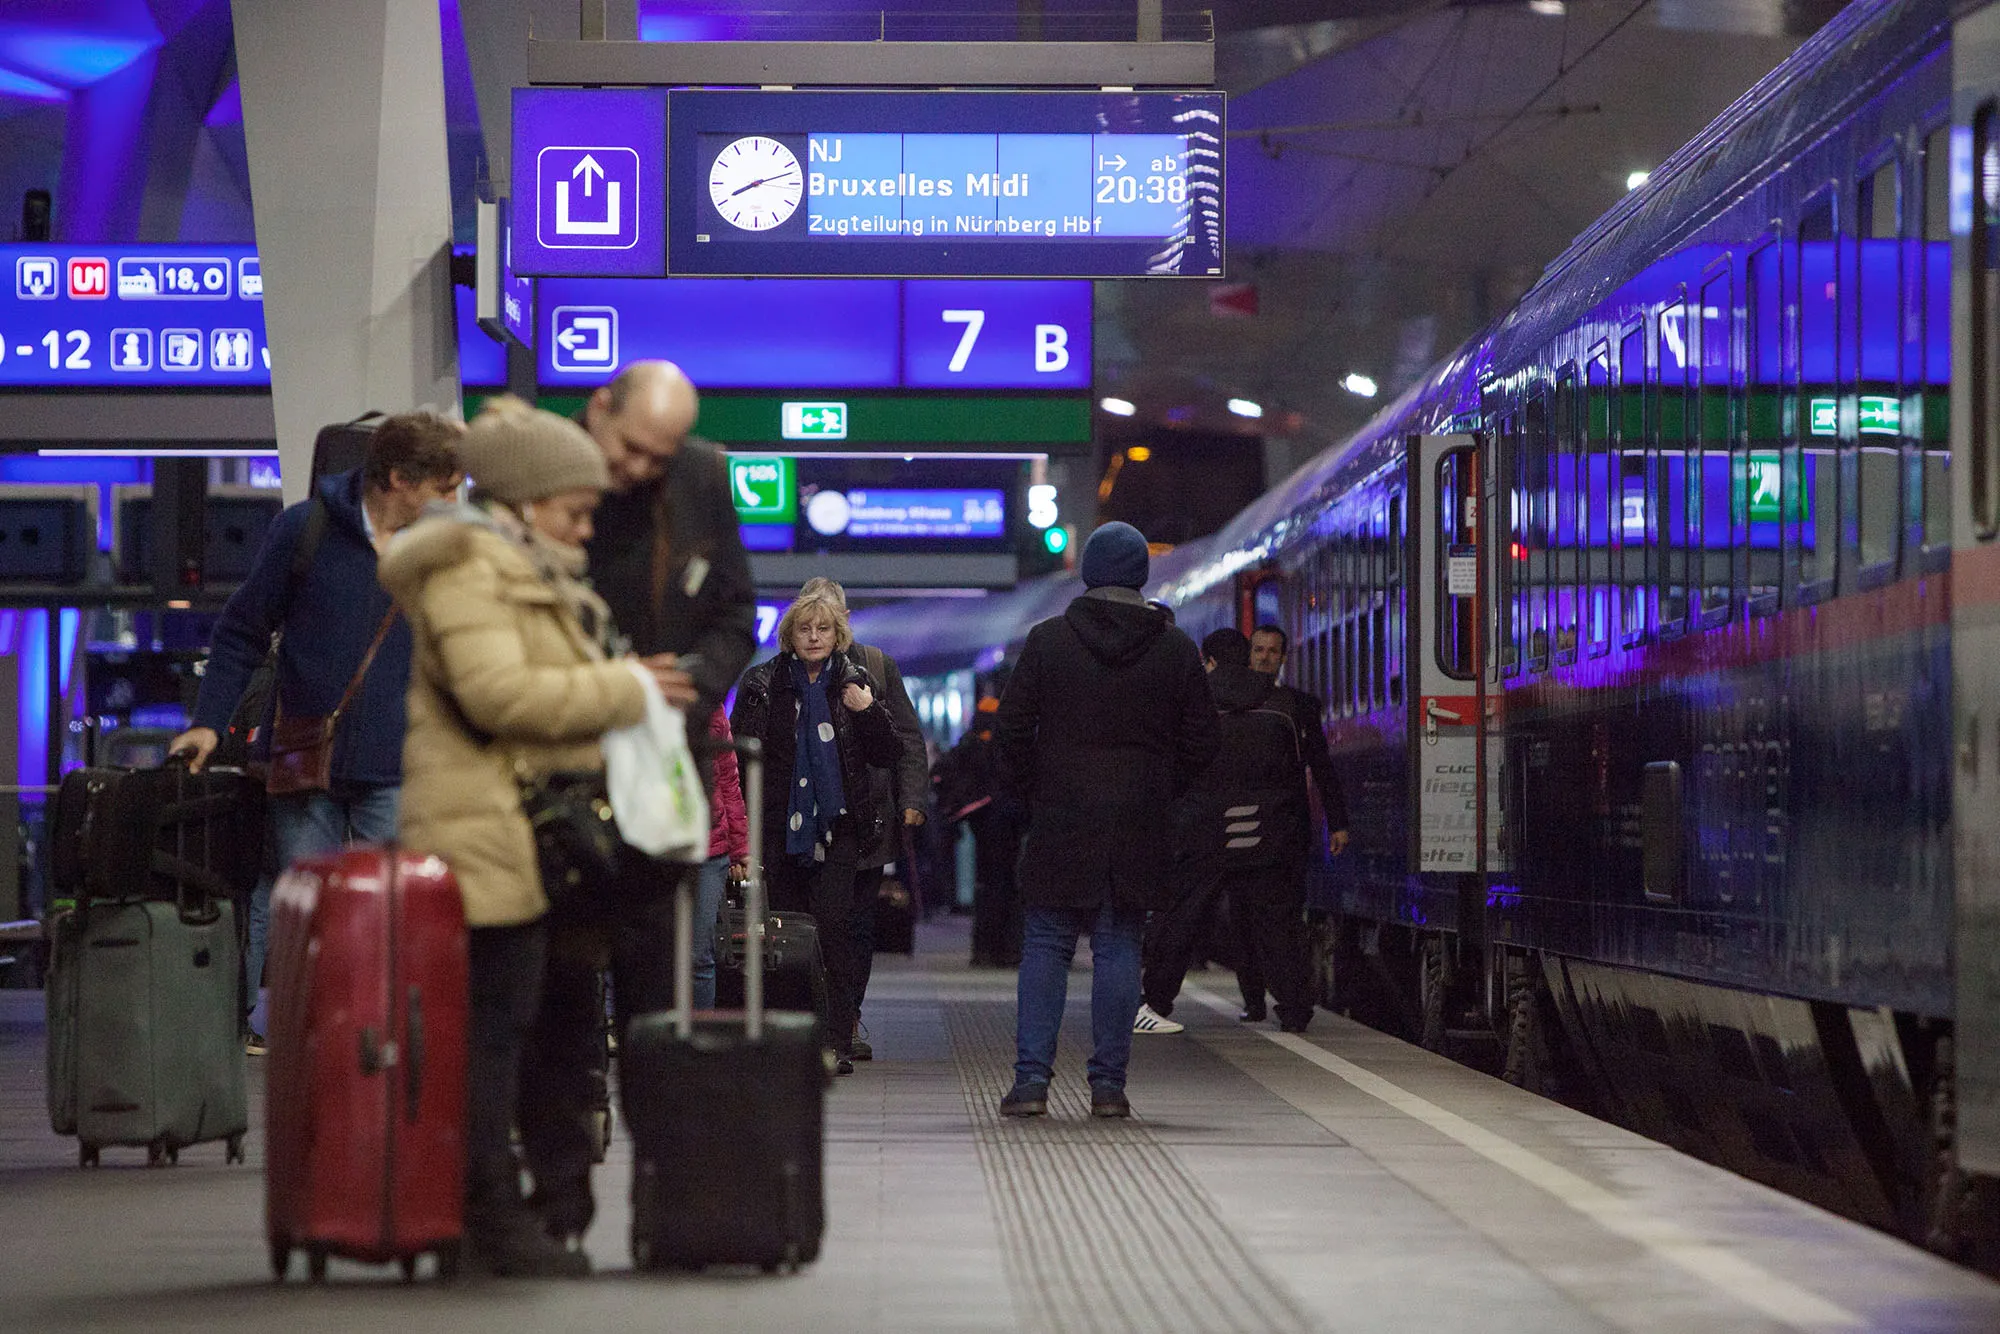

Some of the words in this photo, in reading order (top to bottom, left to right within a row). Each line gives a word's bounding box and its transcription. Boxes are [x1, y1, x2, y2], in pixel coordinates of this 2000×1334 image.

[809, 138, 842, 162] NJ
[1151, 154, 1177, 172] ab
[809, 172, 953, 197] Bruxelles
[966, 173, 1028, 197] Midi
[1096, 175, 1187, 204] 20:38
[809, 214, 924, 236] Zugteilung
[931, 215, 948, 232] in
[955, 215, 1056, 237] Nürnberg
[1063, 215, 1102, 233] Hbf
[73, 266, 104, 292] U1
[942, 309, 985, 372] 7
[1035, 324, 1069, 373] B
[757, 606, 778, 643] 7
[1435, 765, 1477, 774] cuc
[1424, 778, 1477, 798] lieg
